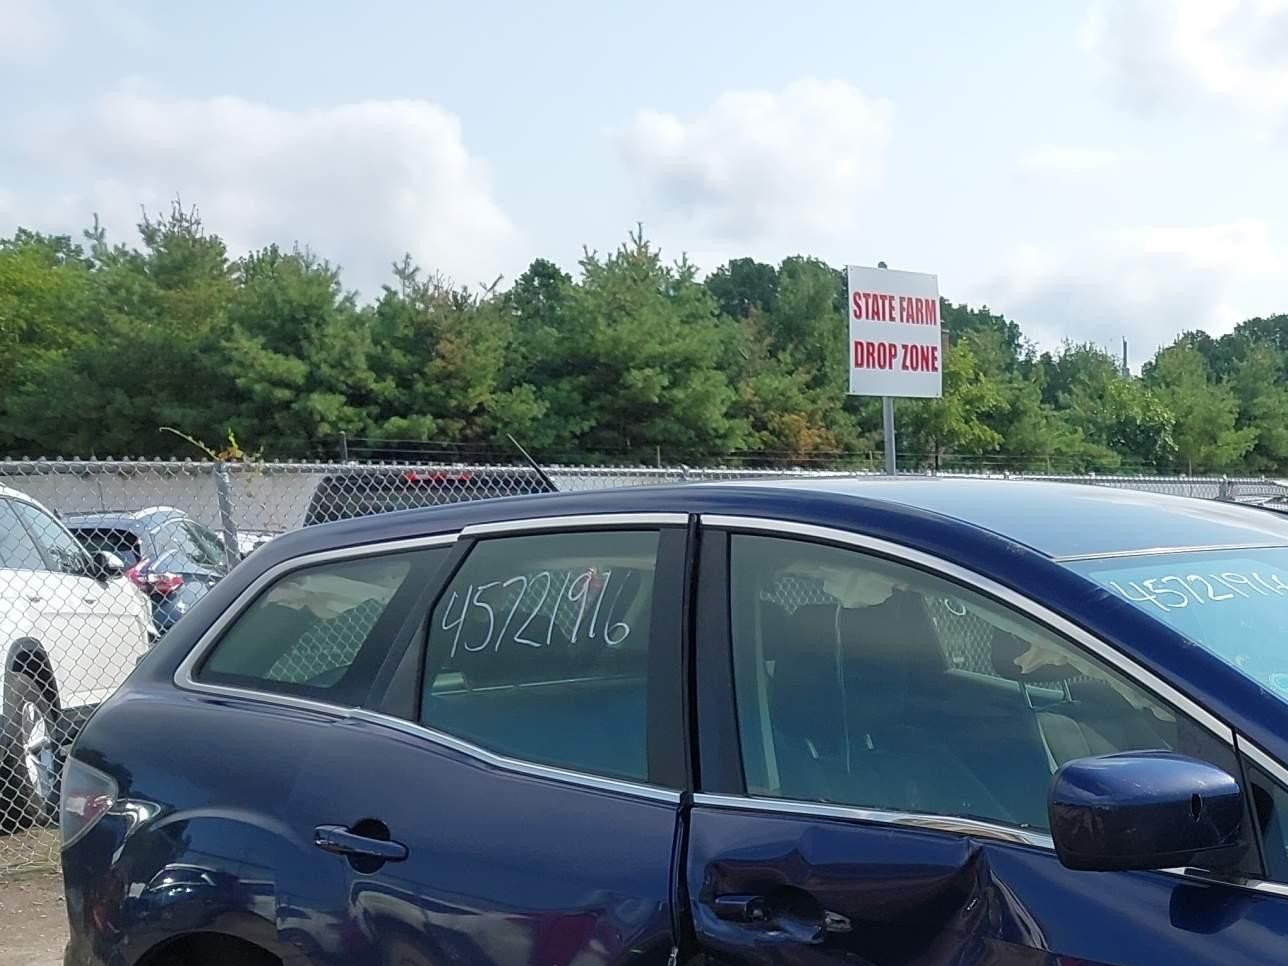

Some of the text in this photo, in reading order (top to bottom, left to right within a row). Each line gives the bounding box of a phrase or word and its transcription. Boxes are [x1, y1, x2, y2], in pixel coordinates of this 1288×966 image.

[852, 291, 938, 326] STATE FARM
[854, 341, 939, 372] DROP ZONE
[442, 569, 632, 658] 45721916
